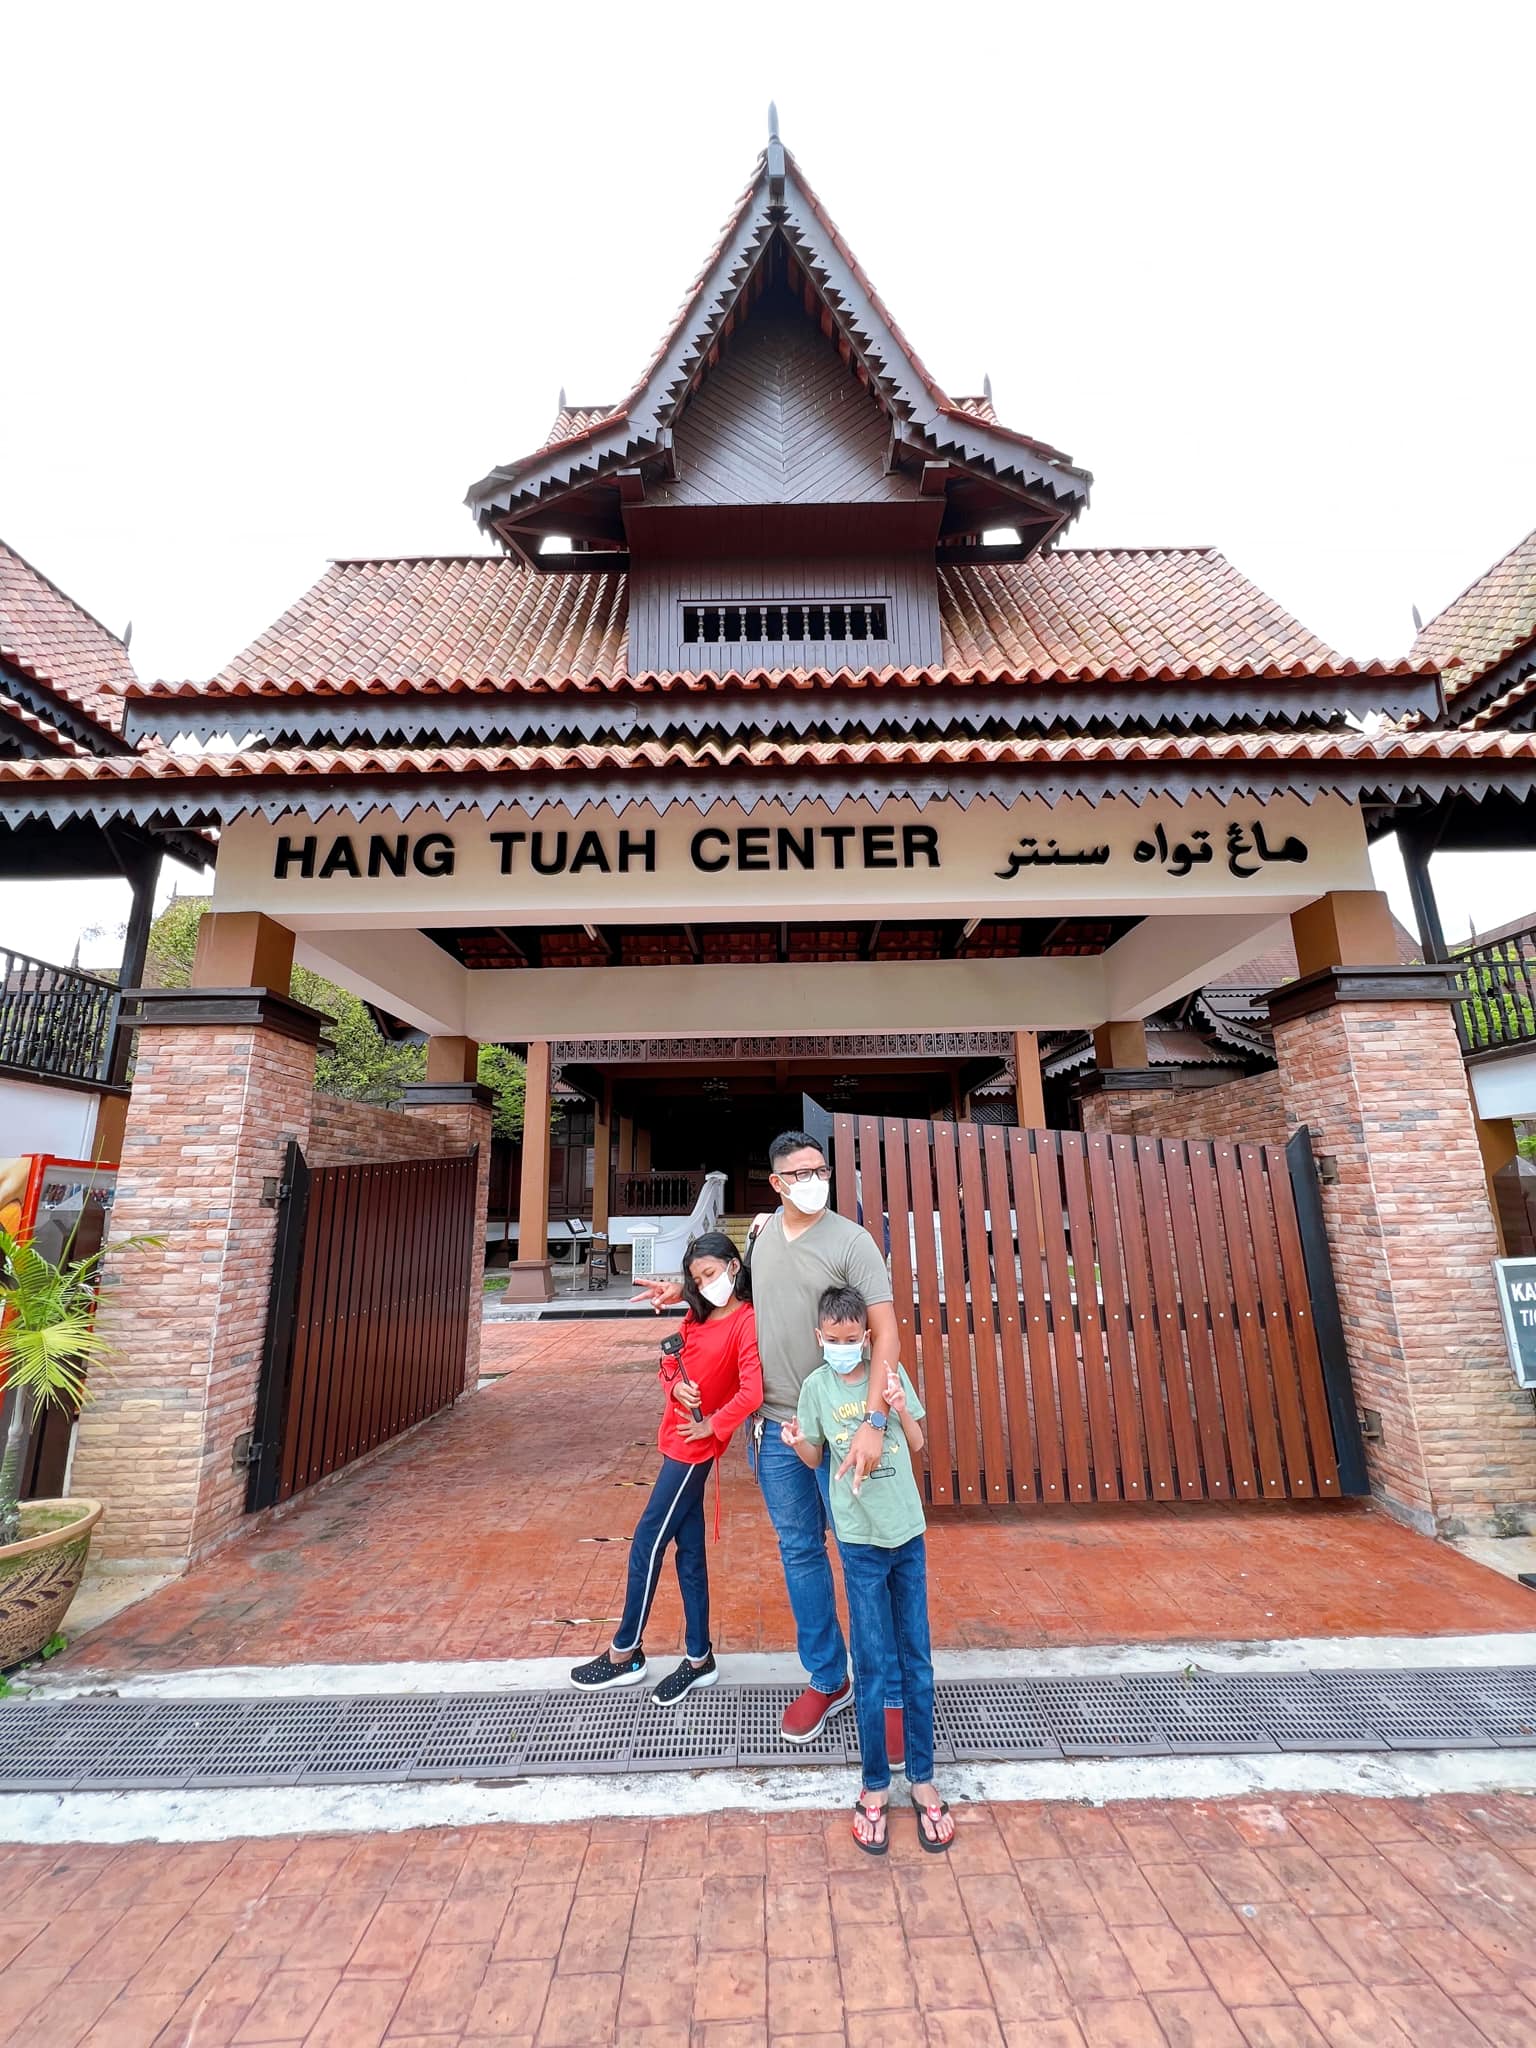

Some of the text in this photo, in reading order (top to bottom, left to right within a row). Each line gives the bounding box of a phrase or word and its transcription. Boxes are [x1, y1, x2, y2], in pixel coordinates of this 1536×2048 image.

[274, 825, 941, 879] HANG TUAH CENTER
[993, 837, 1111, 880] سنتر
[1133, 822, 1214, 877] تواه
[1511, 1282, 1536, 1302] KA
[839, 1401, 859, 1419] CAN
